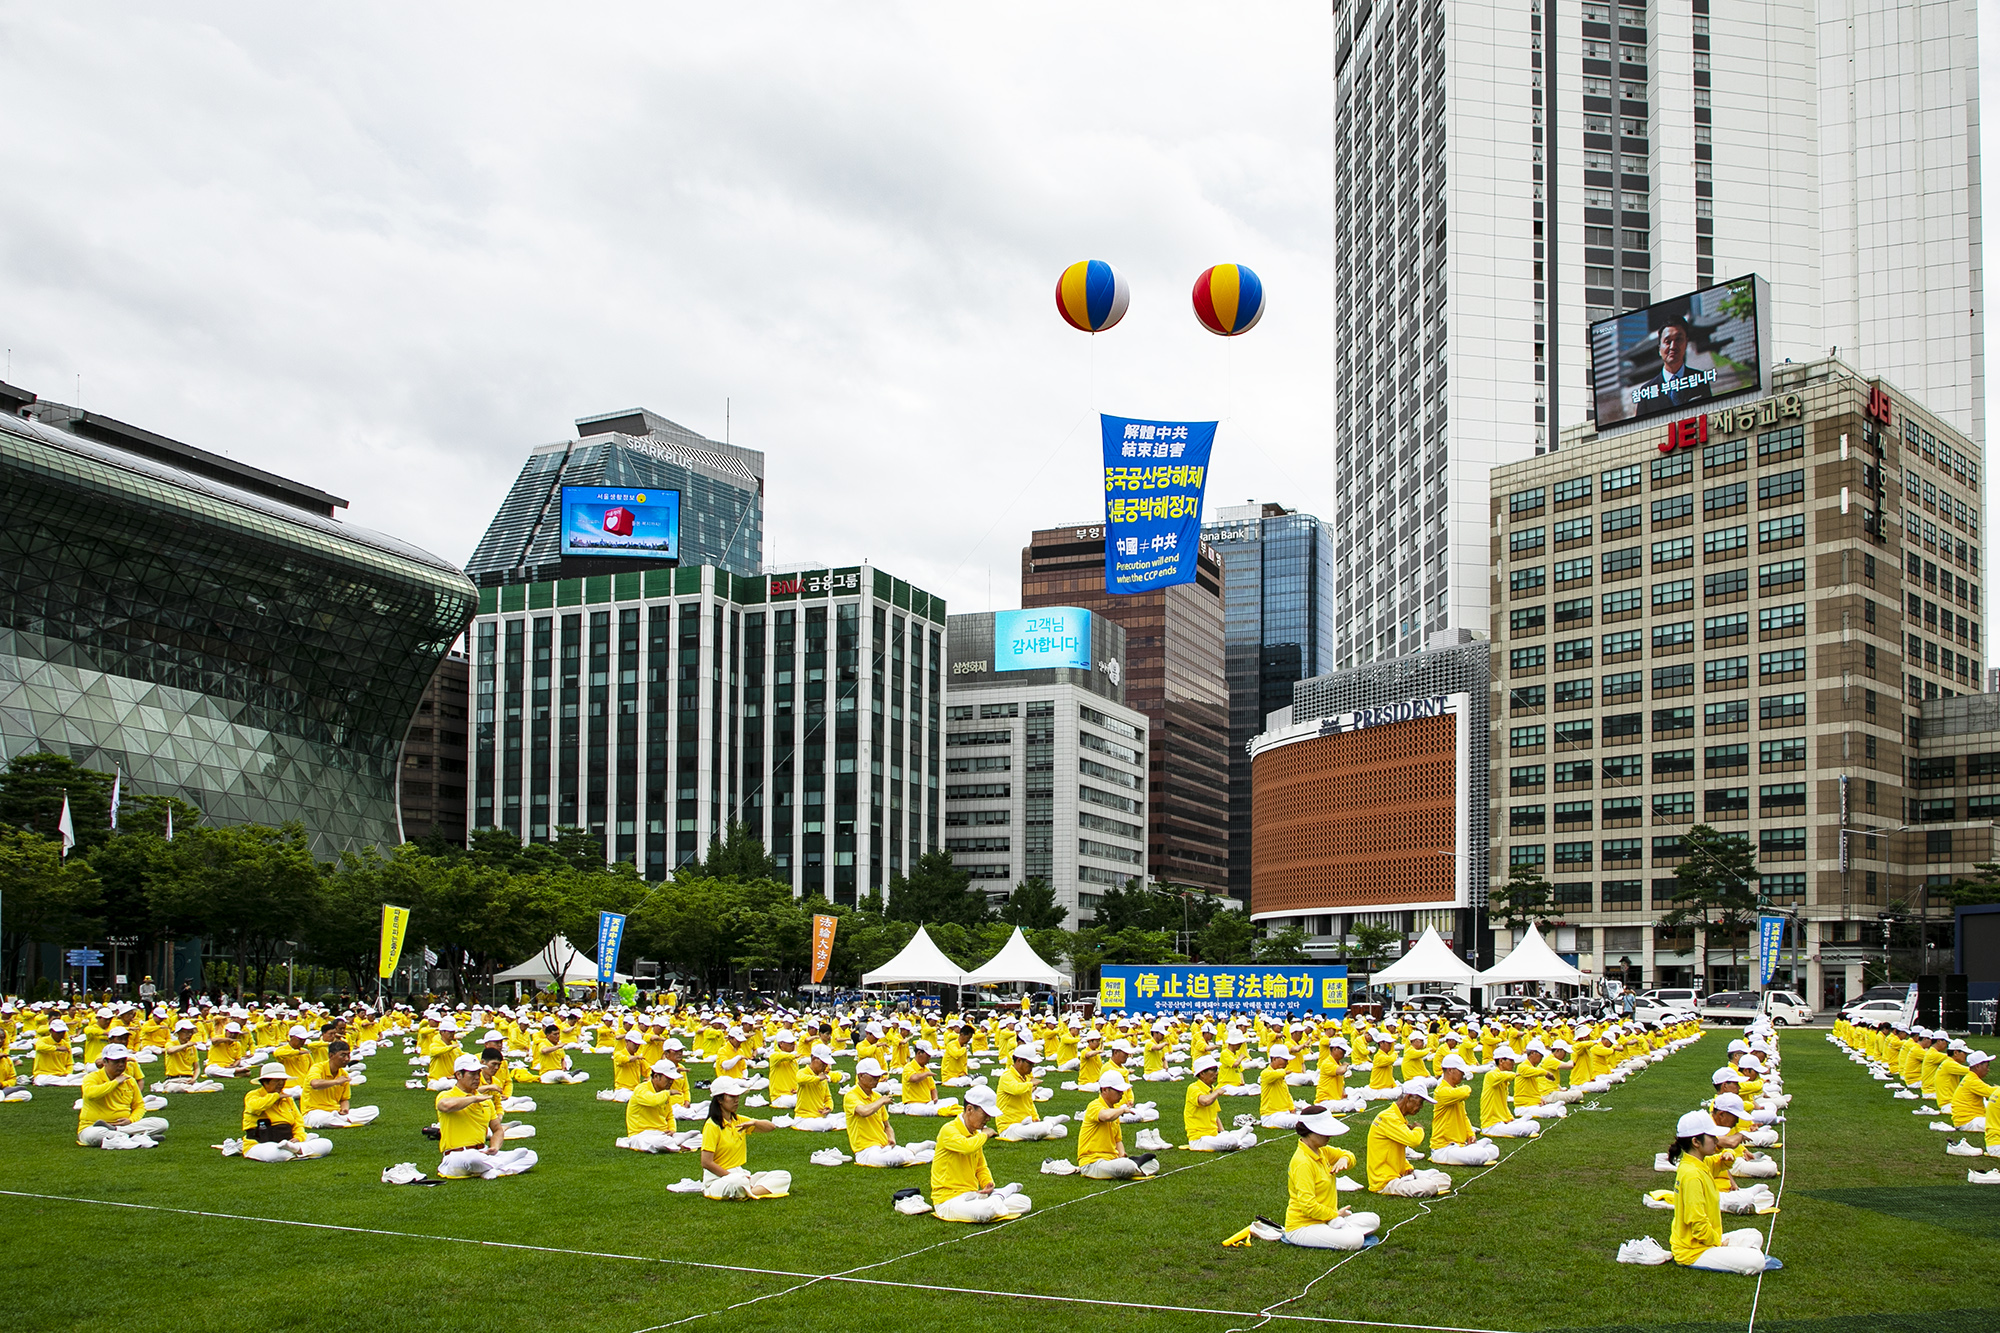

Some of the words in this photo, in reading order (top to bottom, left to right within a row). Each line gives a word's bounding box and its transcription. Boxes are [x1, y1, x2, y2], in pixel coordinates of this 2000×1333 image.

[1632, 384, 1659, 404] 참여를
[1661, 369, 1717, 395] 부탁드립니다
[1867, 387, 1891, 426] JEI
[1658, 414, 1707, 452] JEI
[1714, 394, 1801, 434] 재능교육
[1123, 424, 1188, 440] 解體中共
[1121, 441, 1186, 458] 結束迫害
[1877, 432, 1888, 544] 재능교육
[1076, 528, 1100, 540] 부영
[1221, 529, 1245, 540] Bank
[1152, 556, 1164, 567] will
[1164, 553, 1180, 564] end
[1131, 573, 1143, 582] the
[1144, 570, 1158, 581] CCP
[1159, 565, 1177, 577] ends
[771, 579, 806, 596] BNK
[808, 573, 859, 592] 금융그룹
[1025, 616, 1064, 633] 고객님
[1012, 636, 1079, 655] 감사합니다
[952, 660, 987, 675] 삼성화재
[1353, 696, 1448, 730] PRESIDENT
[816, 917, 833, 971] 法輪大法好
[1105, 990, 1121, 998] 中共
[1134, 973, 1313, 998] 停止迫害法輪功
[1154, 1001, 1192, 1009] 중국공산당이
[1278, 1001, 1285, 1009] 수
[1287, 1001, 1300, 1009] 있다
